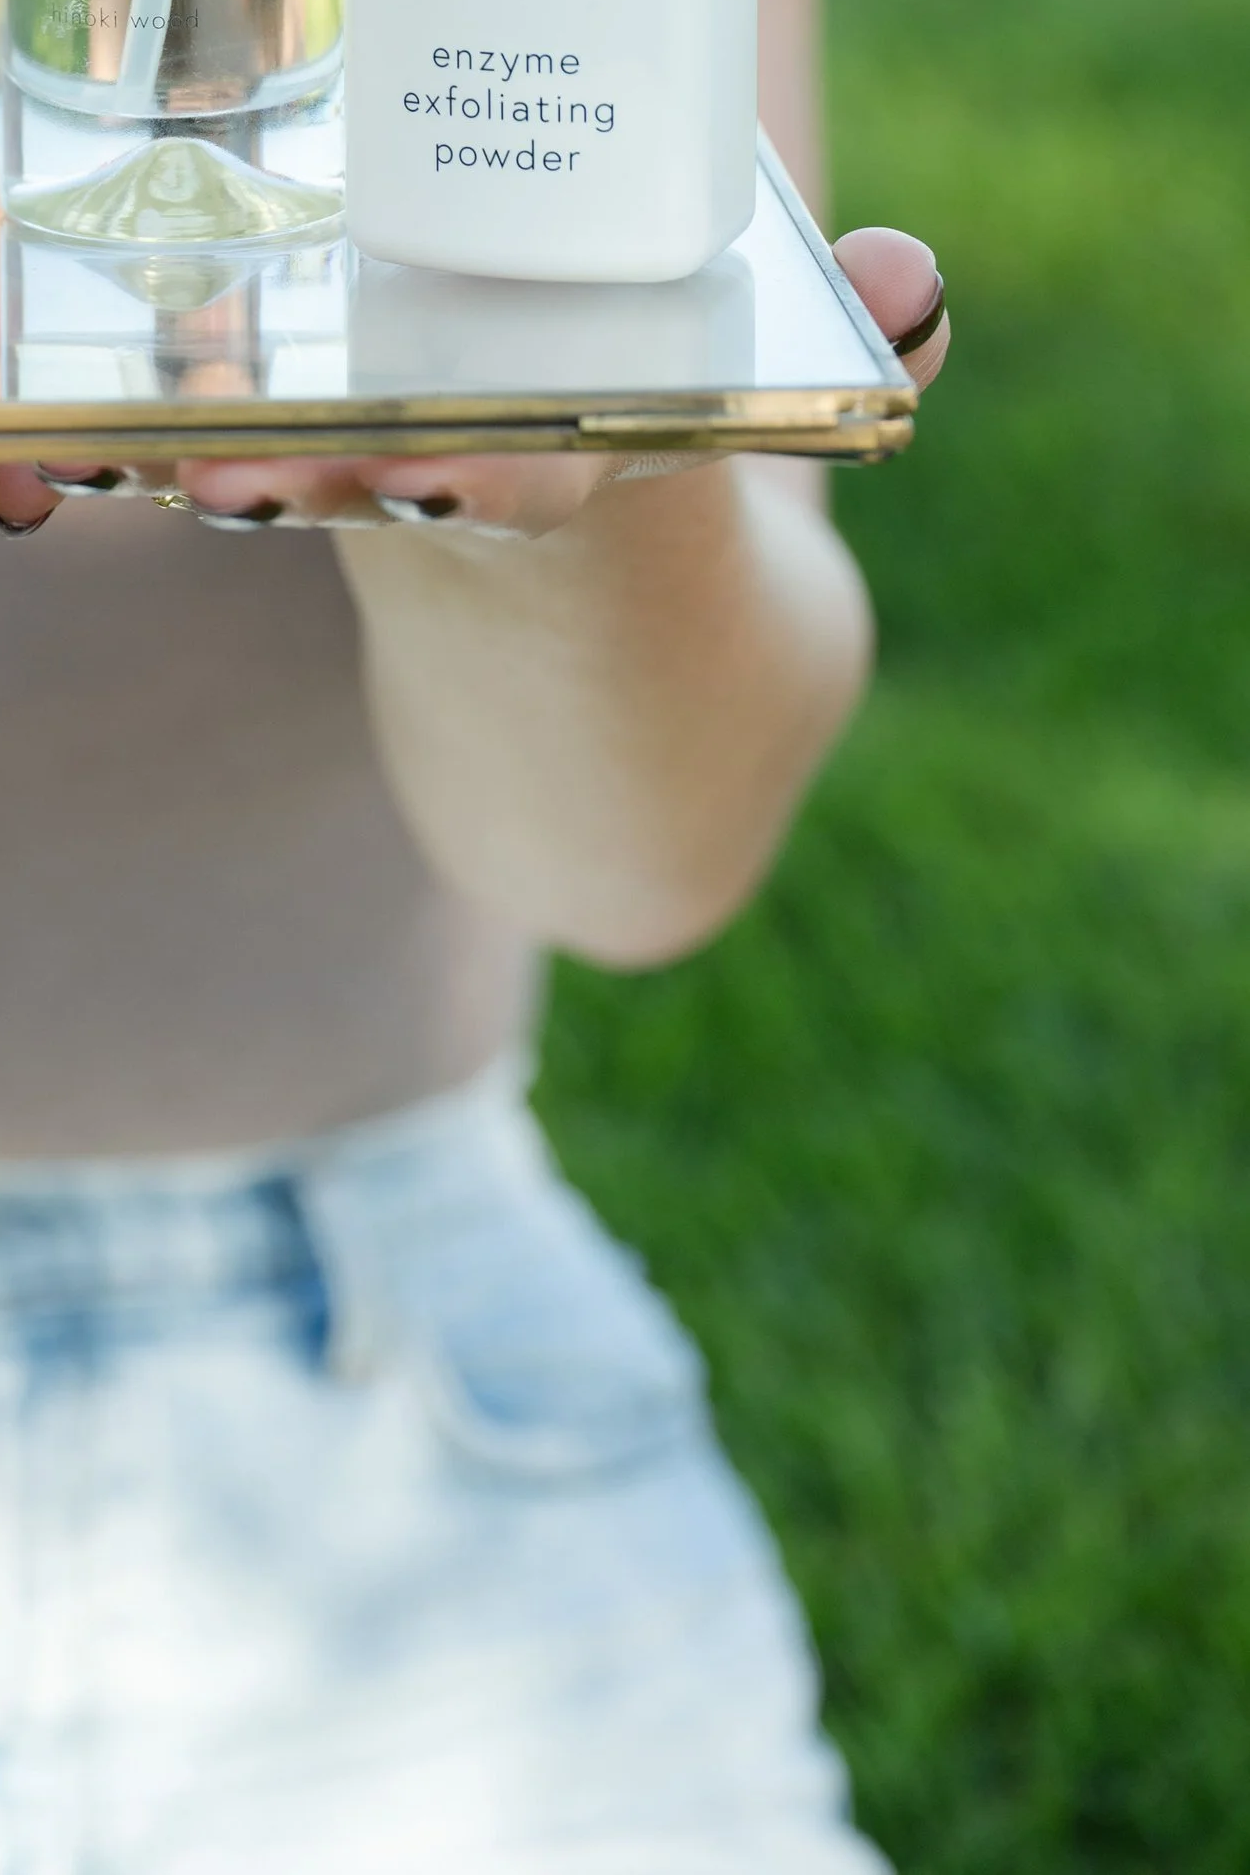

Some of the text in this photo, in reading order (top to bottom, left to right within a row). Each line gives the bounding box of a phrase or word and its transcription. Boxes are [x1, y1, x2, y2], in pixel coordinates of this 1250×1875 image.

[51, 3, 199, 30] hinoki wood
[432, 46, 581, 82] enzyme
[402, 84, 616, 133] exfoliating
[435, 138, 581, 173] powder
